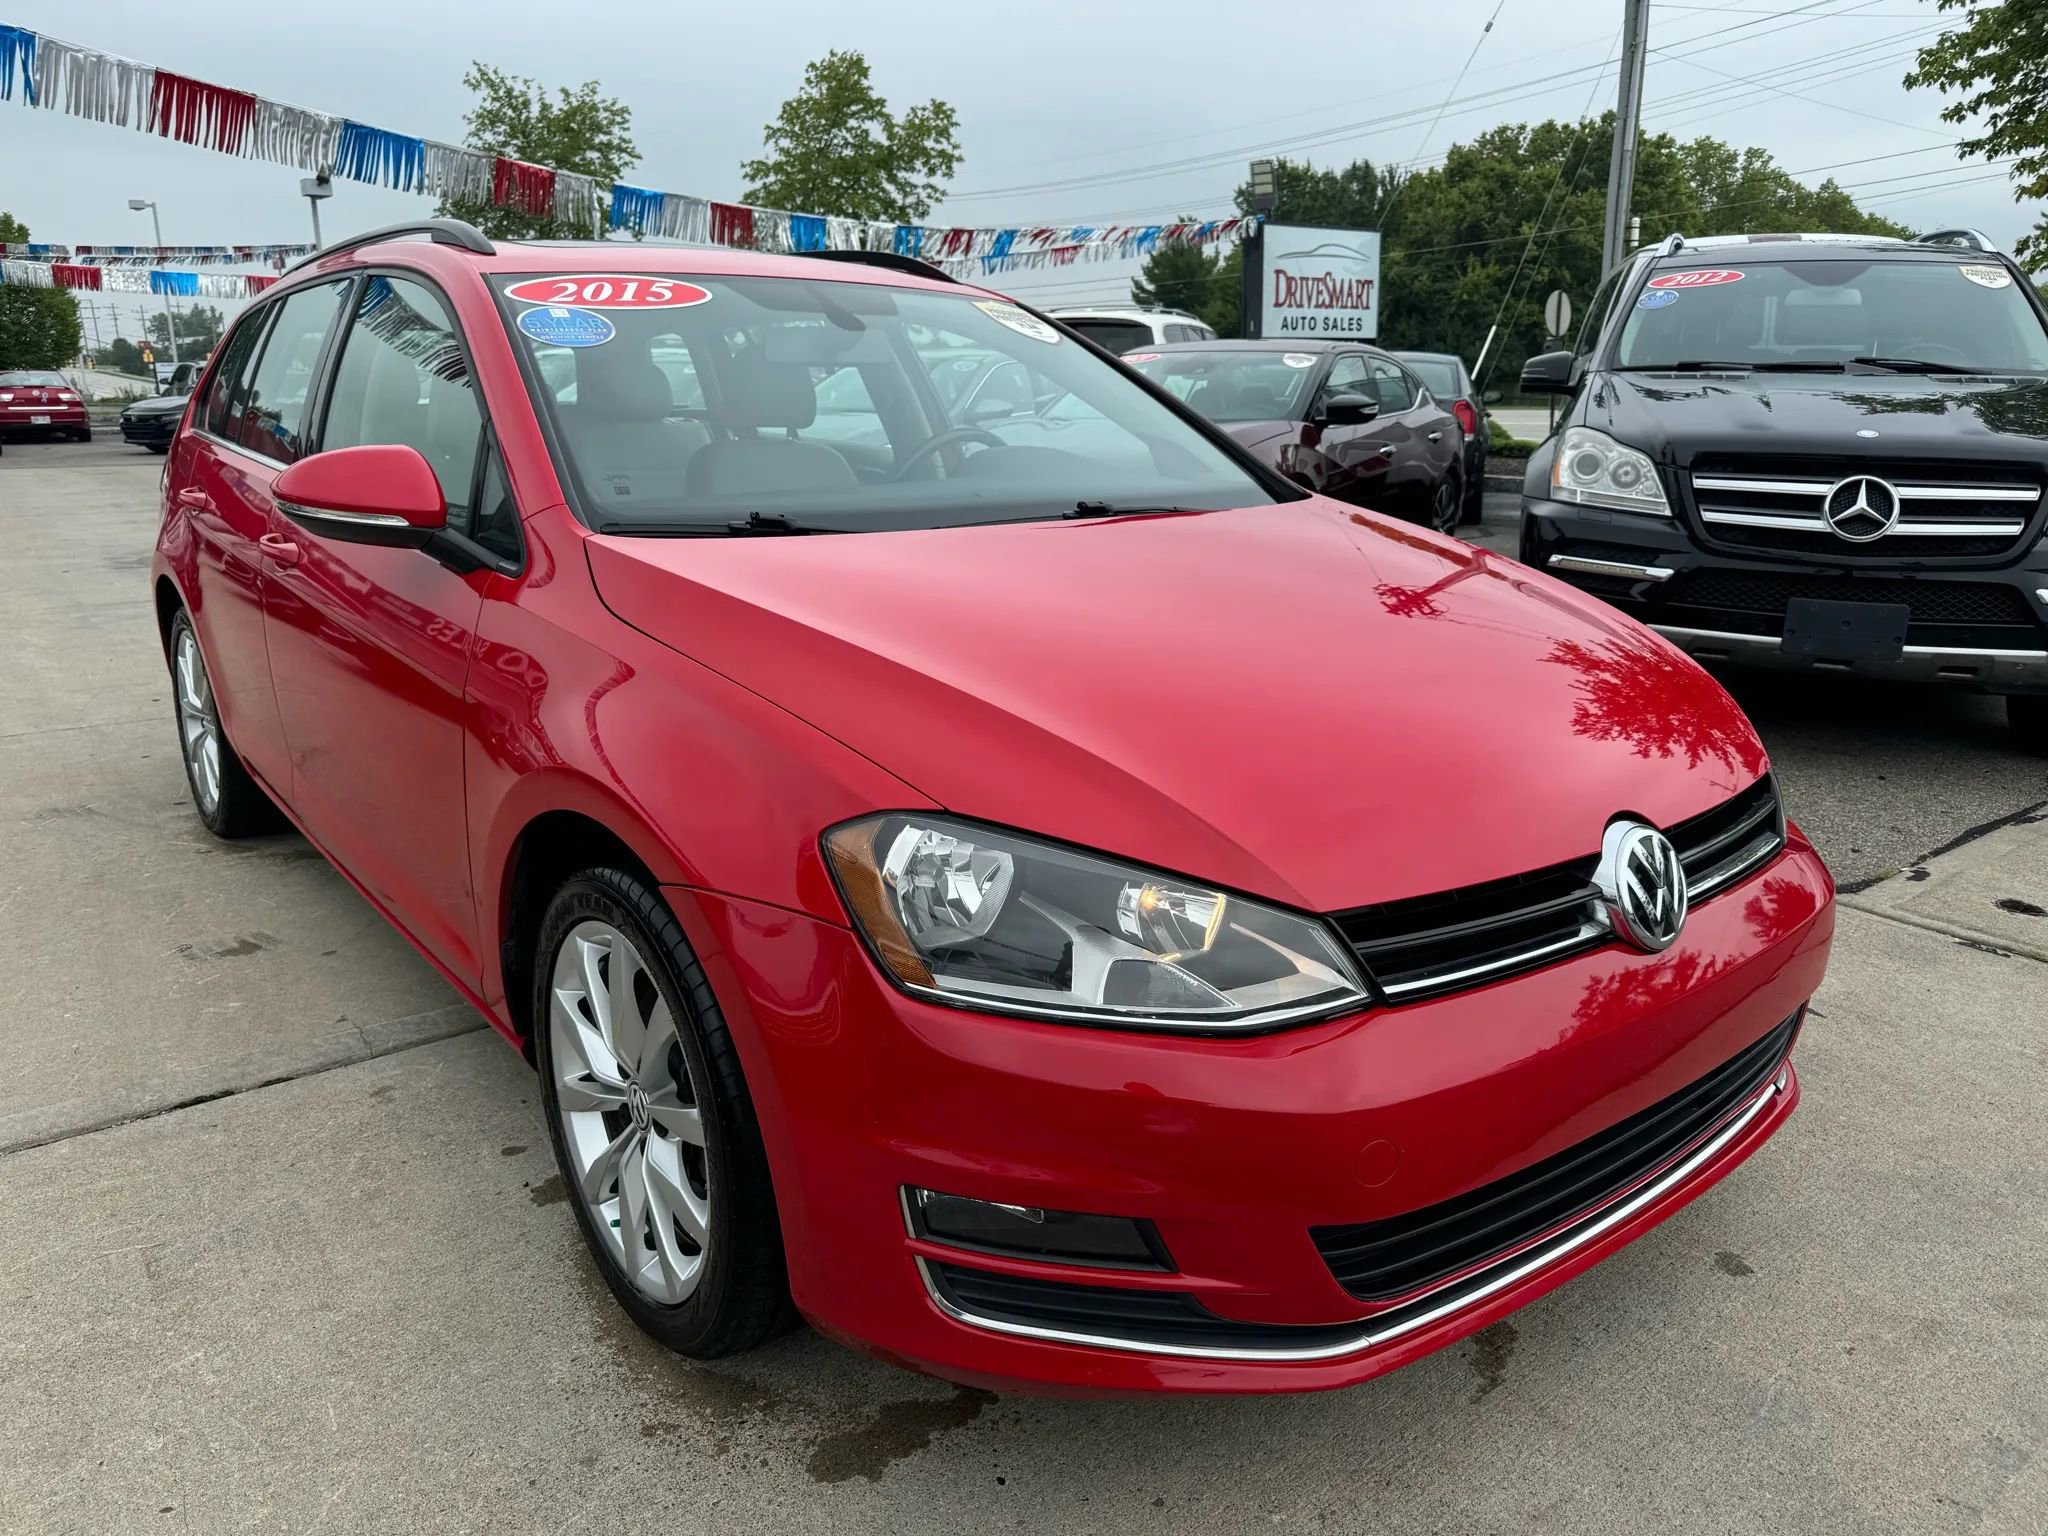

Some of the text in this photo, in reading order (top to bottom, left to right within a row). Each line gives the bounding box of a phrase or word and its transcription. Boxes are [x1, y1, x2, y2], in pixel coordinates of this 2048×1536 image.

[1664, 272, 1729, 286] 2012
[547, 281, 674, 302] 2015
[525, 316, 605, 329] 5 YEAR
[1281, 316, 1363, 331] AUTO SALES
